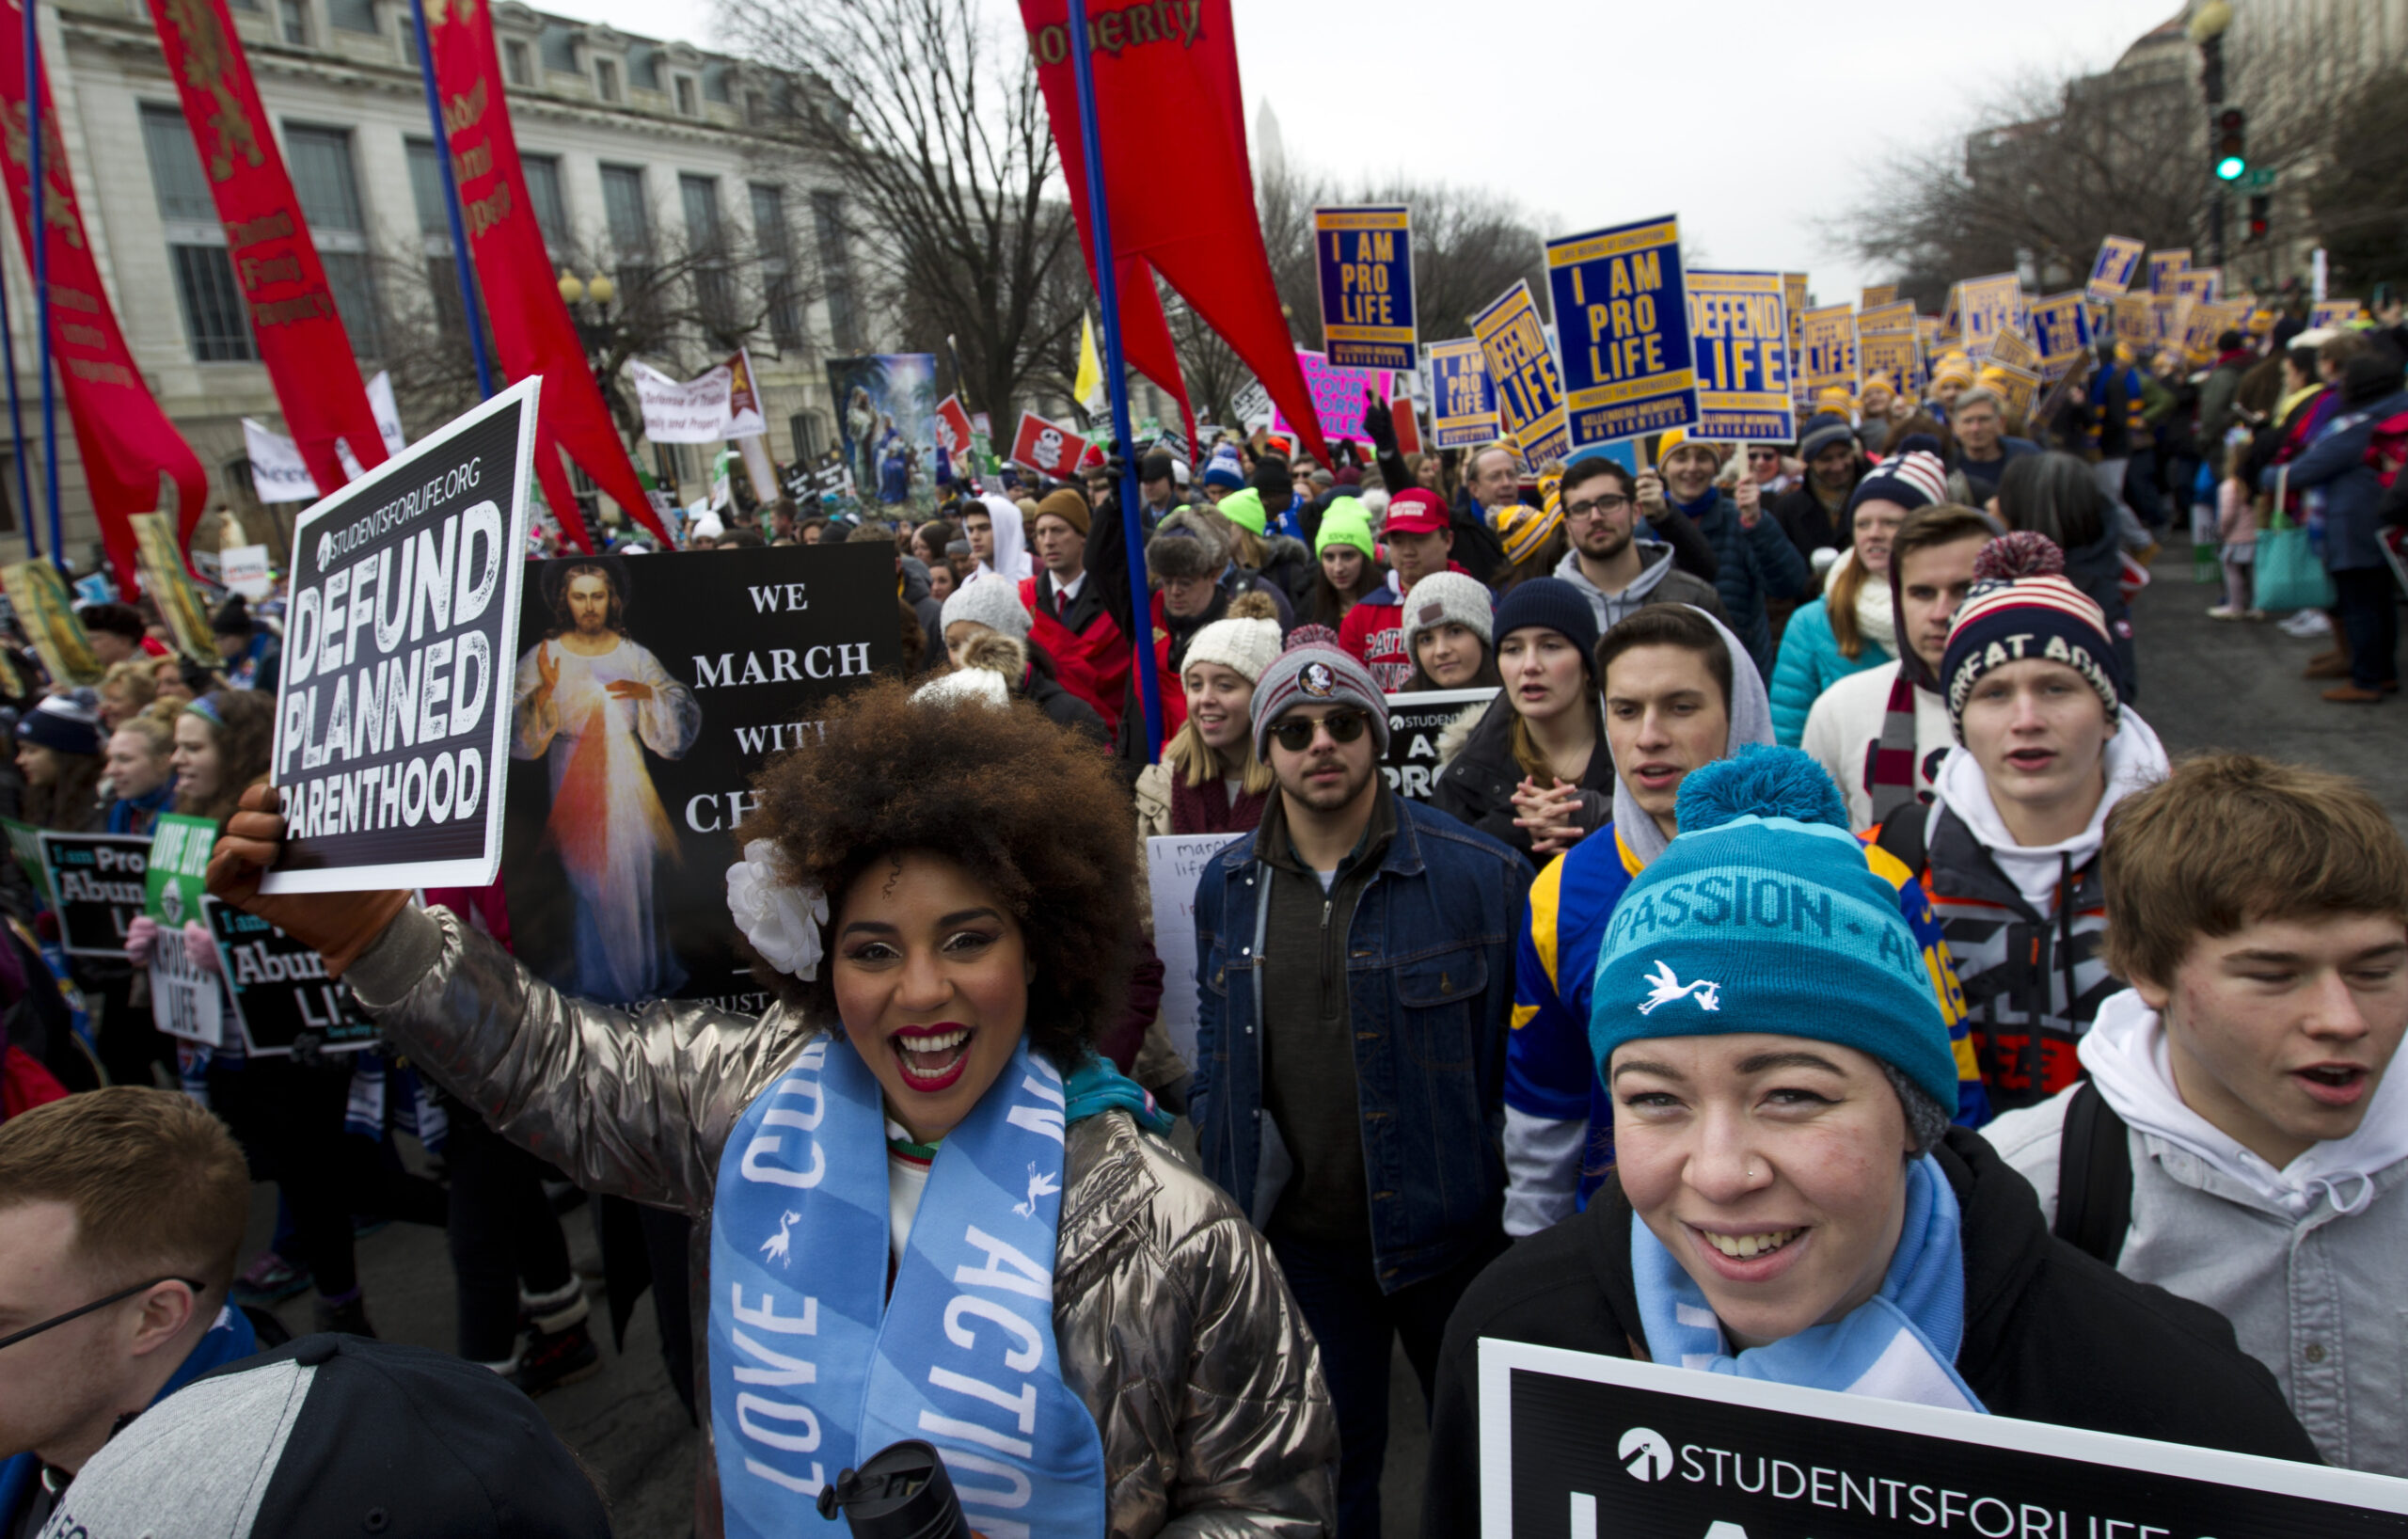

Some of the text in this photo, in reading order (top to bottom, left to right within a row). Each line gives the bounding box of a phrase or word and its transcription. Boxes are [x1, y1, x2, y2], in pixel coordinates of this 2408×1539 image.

[1332, 231, 1394, 262] I AM
[1340, 262, 1389, 294] PRO
[1572, 250, 1662, 306] I AM
[1341, 294, 1394, 325] LIFE
[1587, 294, 1656, 343] PRO
[1687, 294, 1782, 340] DEFEND
[1441, 353, 1485, 376] I AM
[1482, 309, 1545, 384] DEFEND
[1589, 332, 1665, 383] LIFE
[1697, 340, 1786, 391] IFE
[1307, 375, 1362, 398] YOUR
[1447, 373, 1481, 395] PRO
[1447, 393, 1484, 417] LIFE
[1499, 353, 1563, 429] LIFE
[1639, 395, 1686, 416] MEMORIAL
[1582, 407, 1687, 440] MARIANISTS
[331, 456, 482, 560] STUDENTSFORLIFE.ORG
[289, 500, 502, 686] DEFUND
[748, 582, 809, 613] WE
[692, 642, 873, 689] MARCH
[280, 629, 491, 775] PLANNED
[279, 747, 483, 840] PARENTHOOD
[95, 846, 147, 873] Pro
[731, 1281, 825, 1499] LOVE
